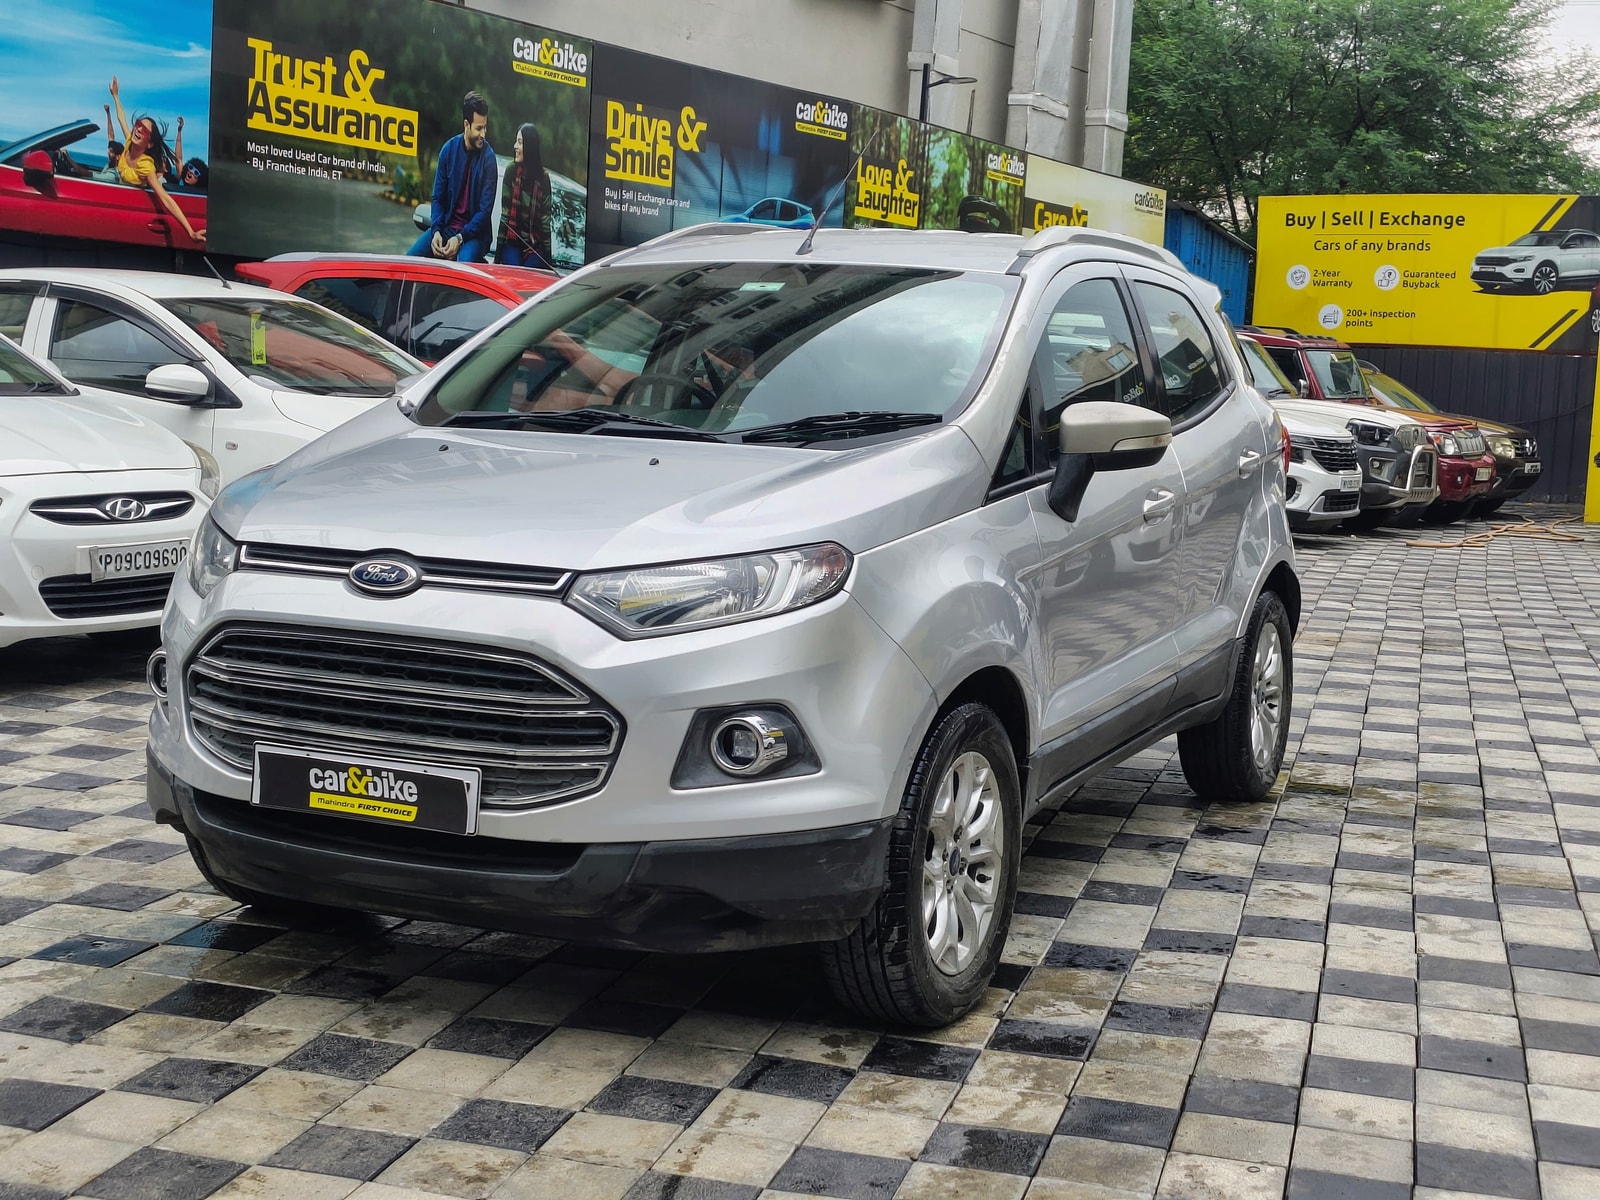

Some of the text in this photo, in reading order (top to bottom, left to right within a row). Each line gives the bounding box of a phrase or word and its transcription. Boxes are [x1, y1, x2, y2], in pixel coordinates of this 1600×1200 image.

[513, 37, 587, 73] car&bike
[247, 37, 385, 104] Trust &
[543, 70, 560, 79] FIRST
[560, 74, 580, 84] CHOICE
[247, 80, 415, 148] Assurance
[796, 101, 848, 129] car&bike
[606, 100, 707, 152] Drive &
[247, 141, 386, 174] Most loved Used Car brand of India
[605, 136, 671, 180] Smile
[252, 157, 264, 170] By
[266, 160, 306, 175] Franchise
[308, 166, 330, 180] India,
[332, 170, 342, 180] ET
[857, 156, 915, 192] Love &
[604, 187, 618, 200] Buy
[622, 189, 633, 200] Sell
[637, 192, 665, 206] Exchange
[666, 198, 678, 207] cars
[679, 199, 691, 208] and
[604, 199, 659, 216] bikes of any brand
[856, 181, 918, 219] Laughter
[1285, 213, 1316, 230] Buy
[1331, 211, 1364, 226] Sell
[1379, 211, 1466, 230] Exchange
[1313, 239, 1431, 253] Cars of any brands
[1313, 269, 1341, 278] 2-Year
[1403, 270, 1457, 279] Guaranteed
[1312, 280, 1353, 288] Warranty
[1402, 280, 1440, 290] Buyback
[1345, 319, 1373, 328] points
[1346, 309, 1416, 319] 200+ inspection
[362, 564, 400, 582] Ford
[309, 766, 418, 803] car&bike
[317, 797, 413, 817] Mahindra FIRST CHOICE
